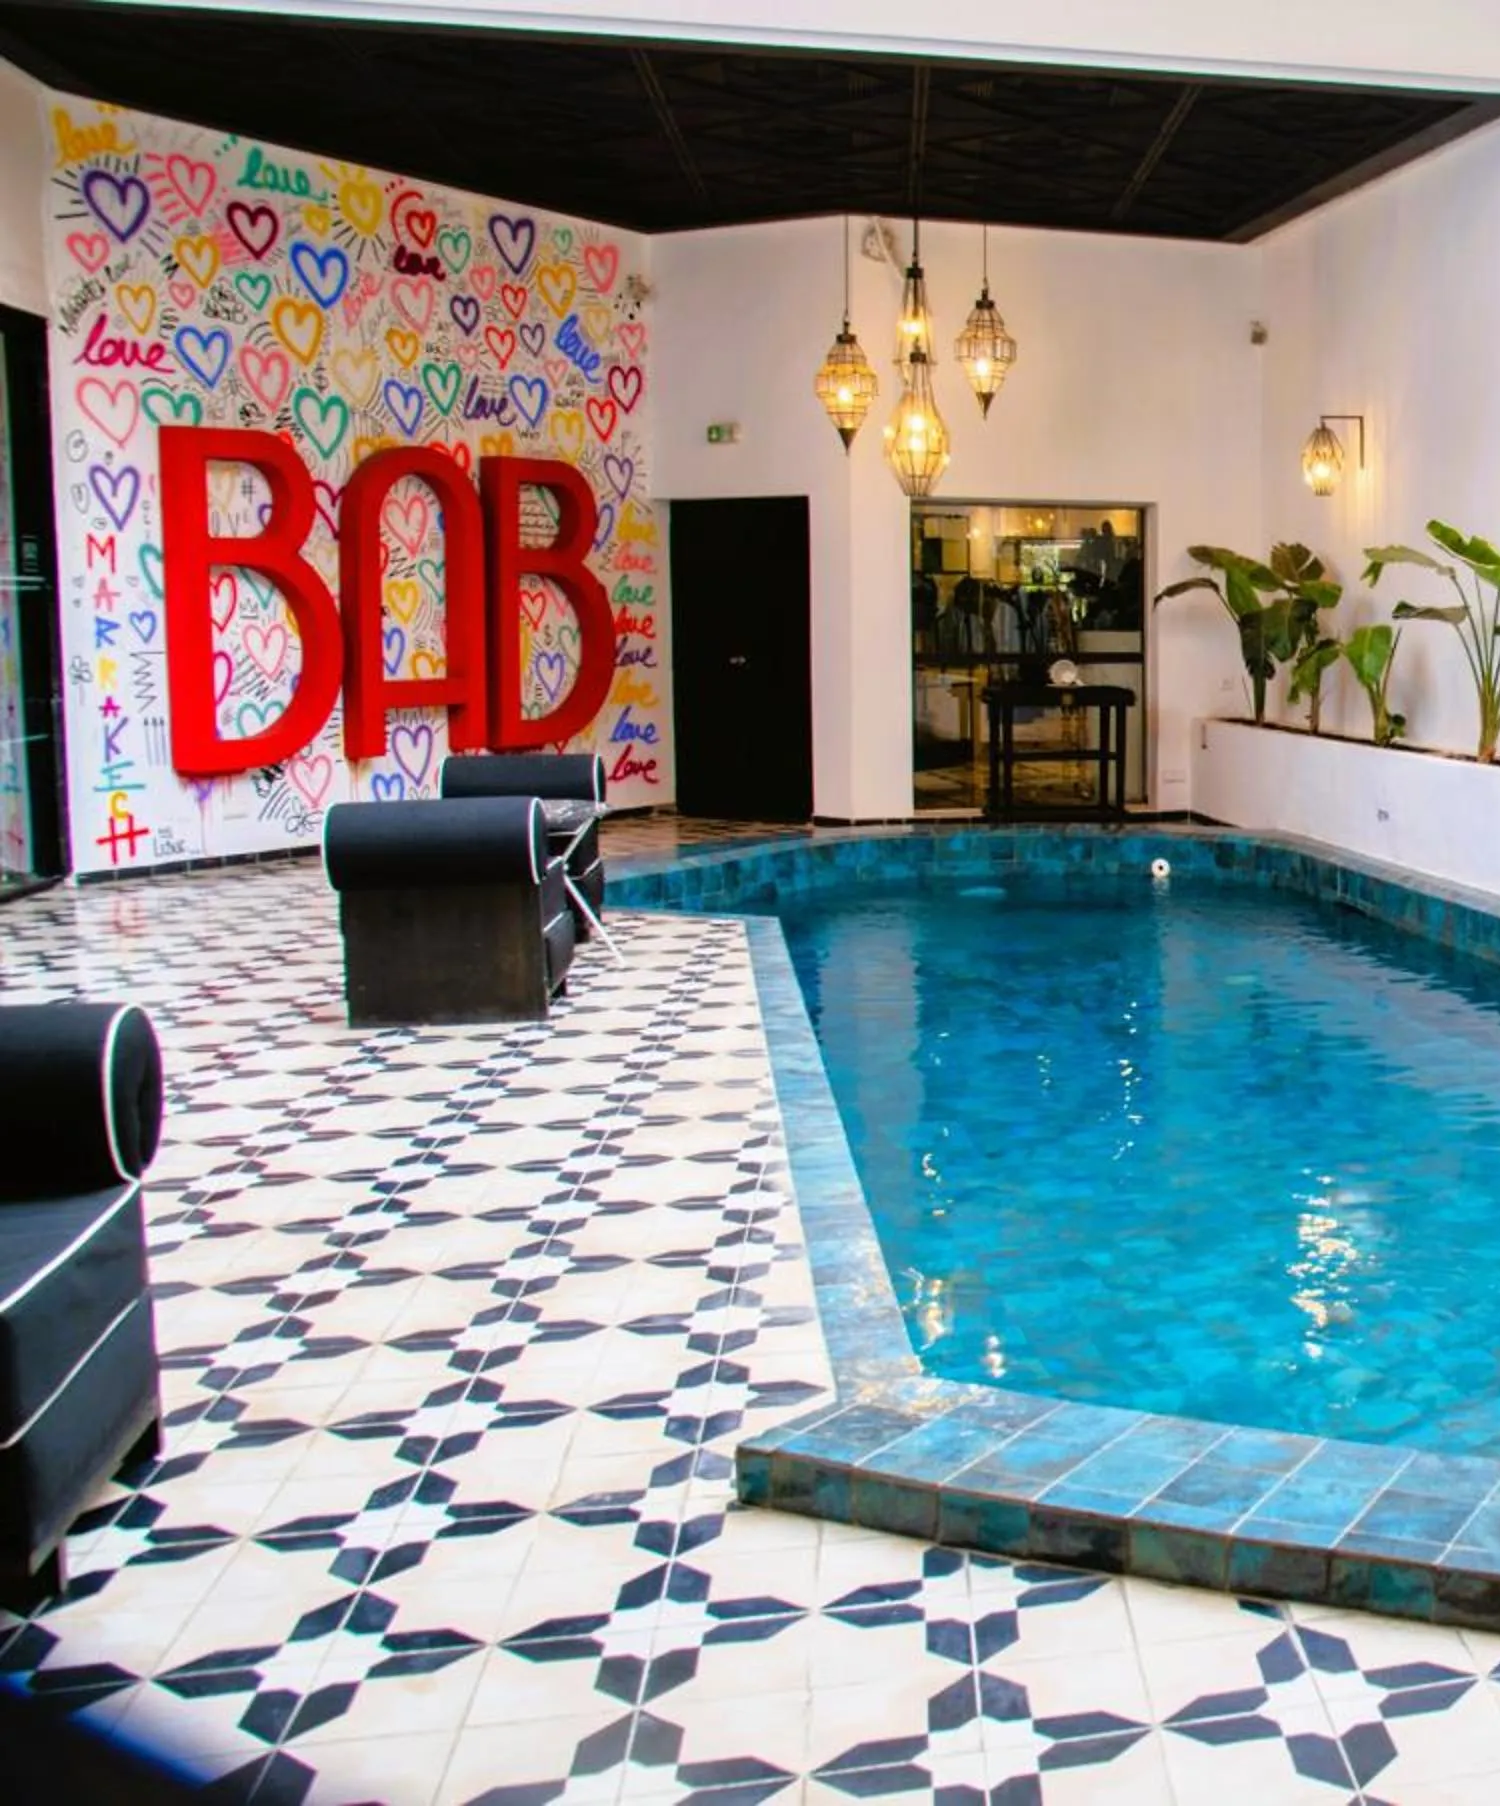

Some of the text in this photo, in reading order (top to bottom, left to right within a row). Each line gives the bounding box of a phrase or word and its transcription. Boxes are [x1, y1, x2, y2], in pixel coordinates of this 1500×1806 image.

[73, 313, 176, 374] love
[463, 374, 518, 427] love
[158, 424, 616, 778] BAB
[612, 574, 656, 606] love
[609, 705, 660, 744] love
[608, 743, 660, 785] love
